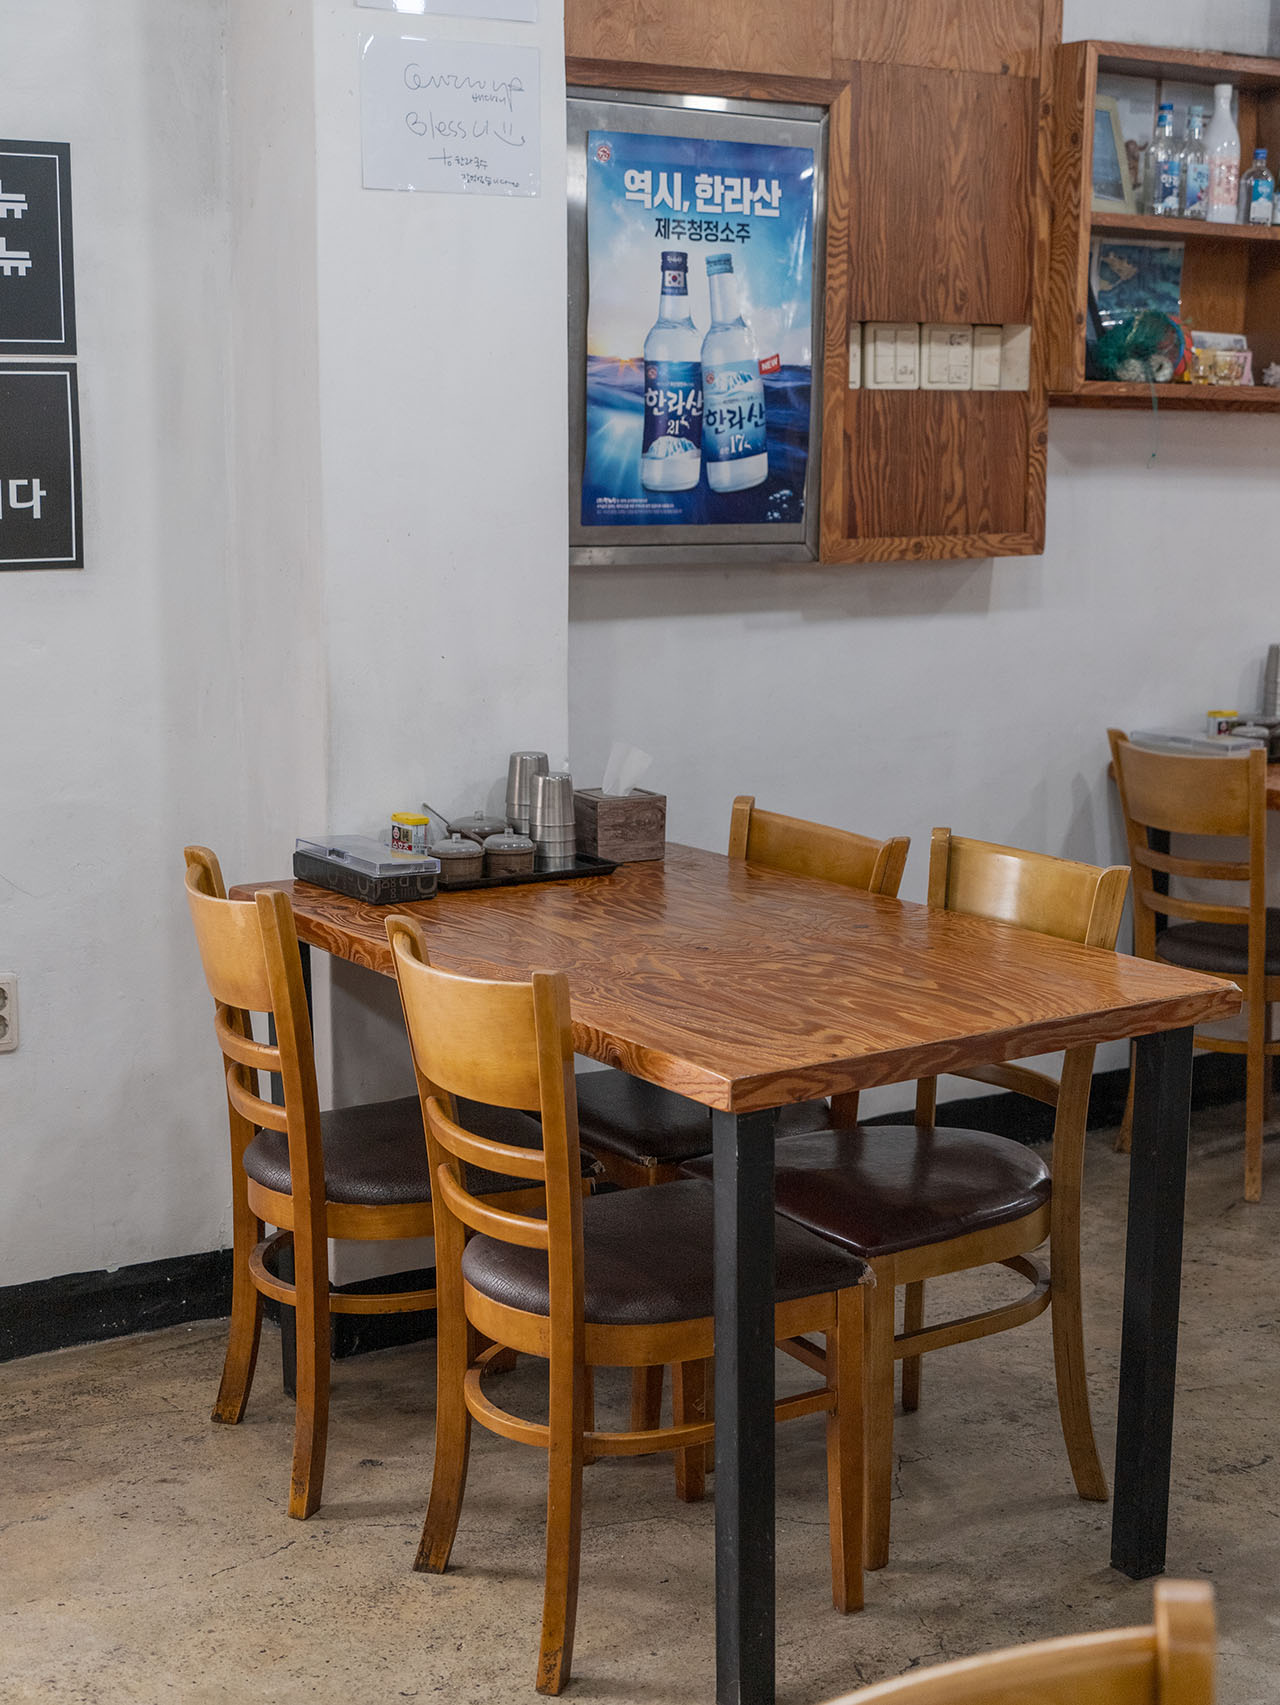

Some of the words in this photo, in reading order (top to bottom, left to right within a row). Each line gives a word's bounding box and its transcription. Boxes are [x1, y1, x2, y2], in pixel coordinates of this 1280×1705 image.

[405, 111, 467, 140] Bless
[623, 168, 690, 213] 역시,
[694, 173, 783, 218] 한라산
[654, 217, 752, 244] 제주청정소주
[760, 357, 779, 372] NEW
[644, 386, 704, 416] 한라산
[704, 402, 767, 435] 한라산
[0, 478, 47, 520] 다
